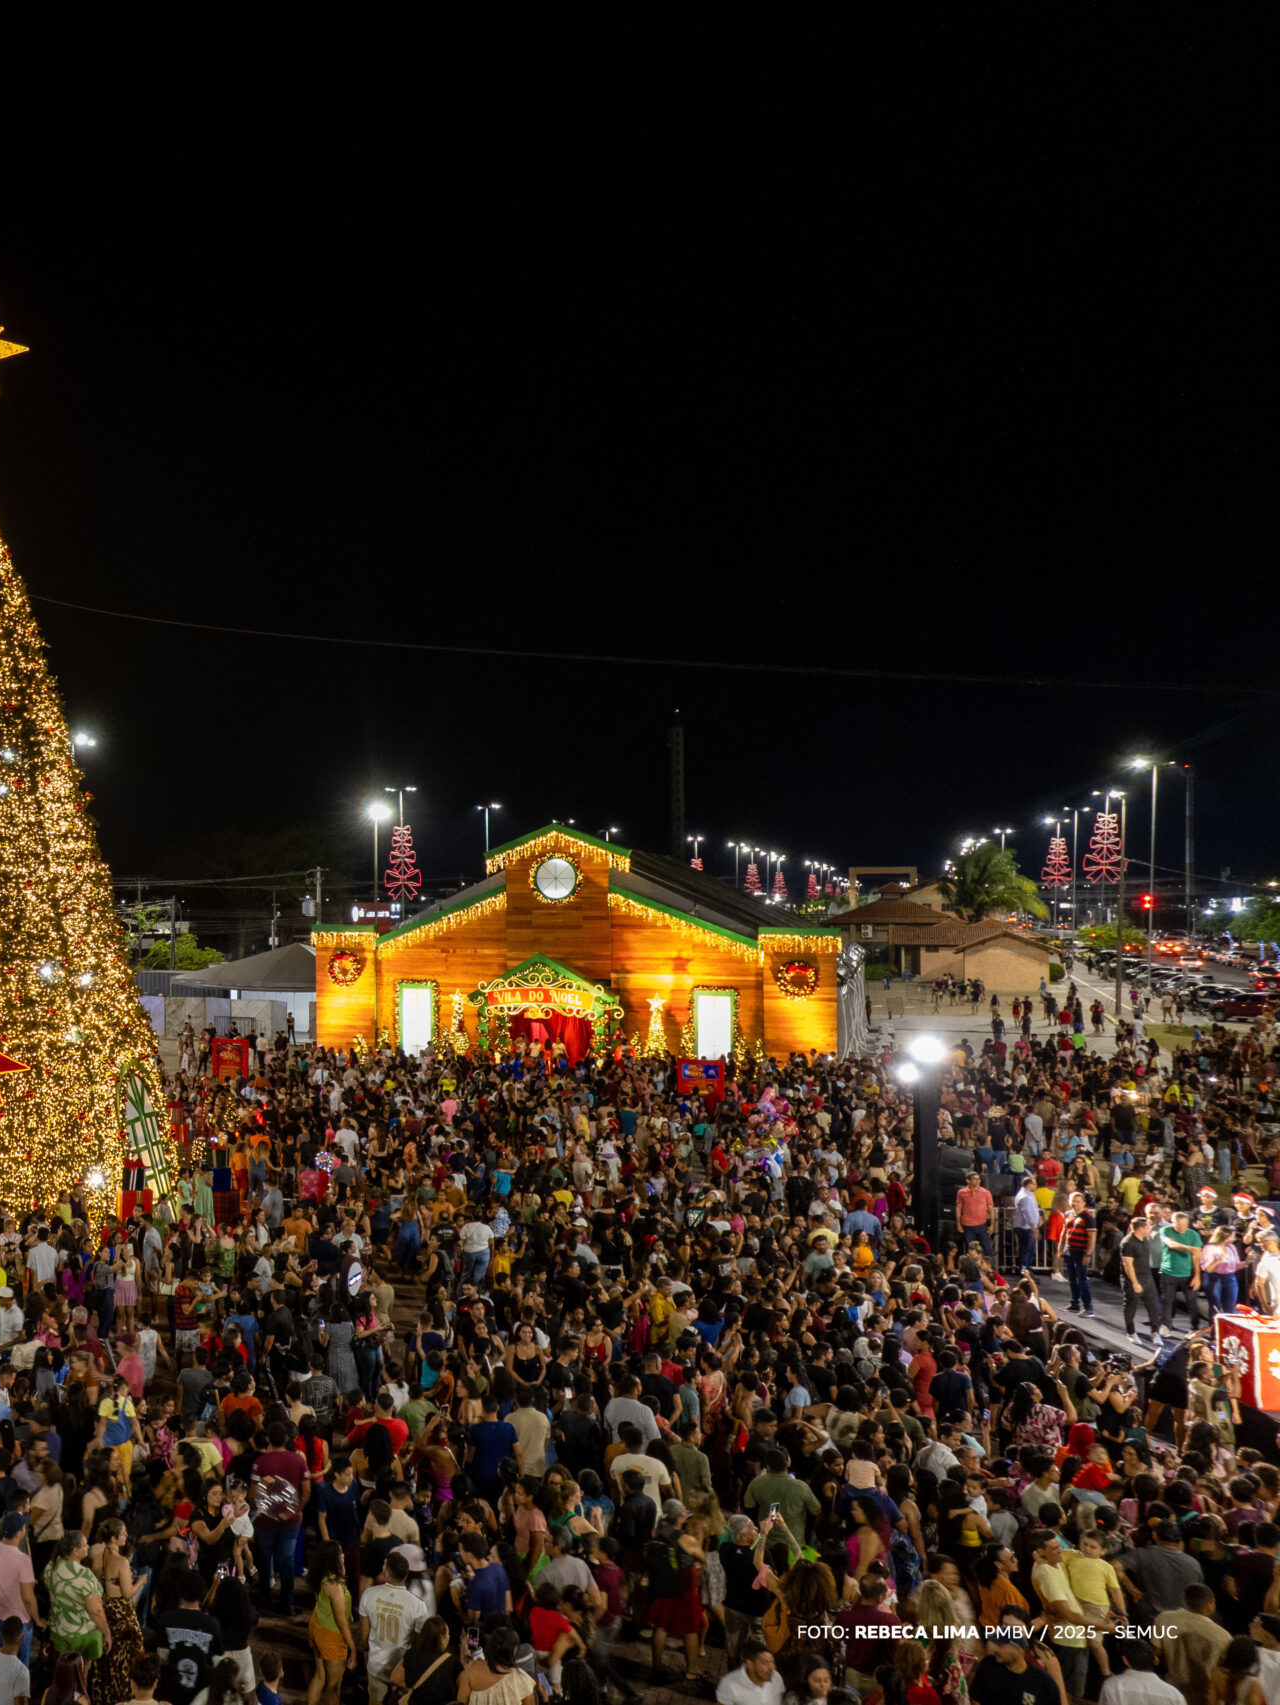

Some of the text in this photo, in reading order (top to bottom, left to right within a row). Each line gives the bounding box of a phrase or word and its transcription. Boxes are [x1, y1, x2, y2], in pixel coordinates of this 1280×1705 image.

[493, 989, 582, 1006] VILA DO NOEL
[376, 1612, 399, 1644] 10
